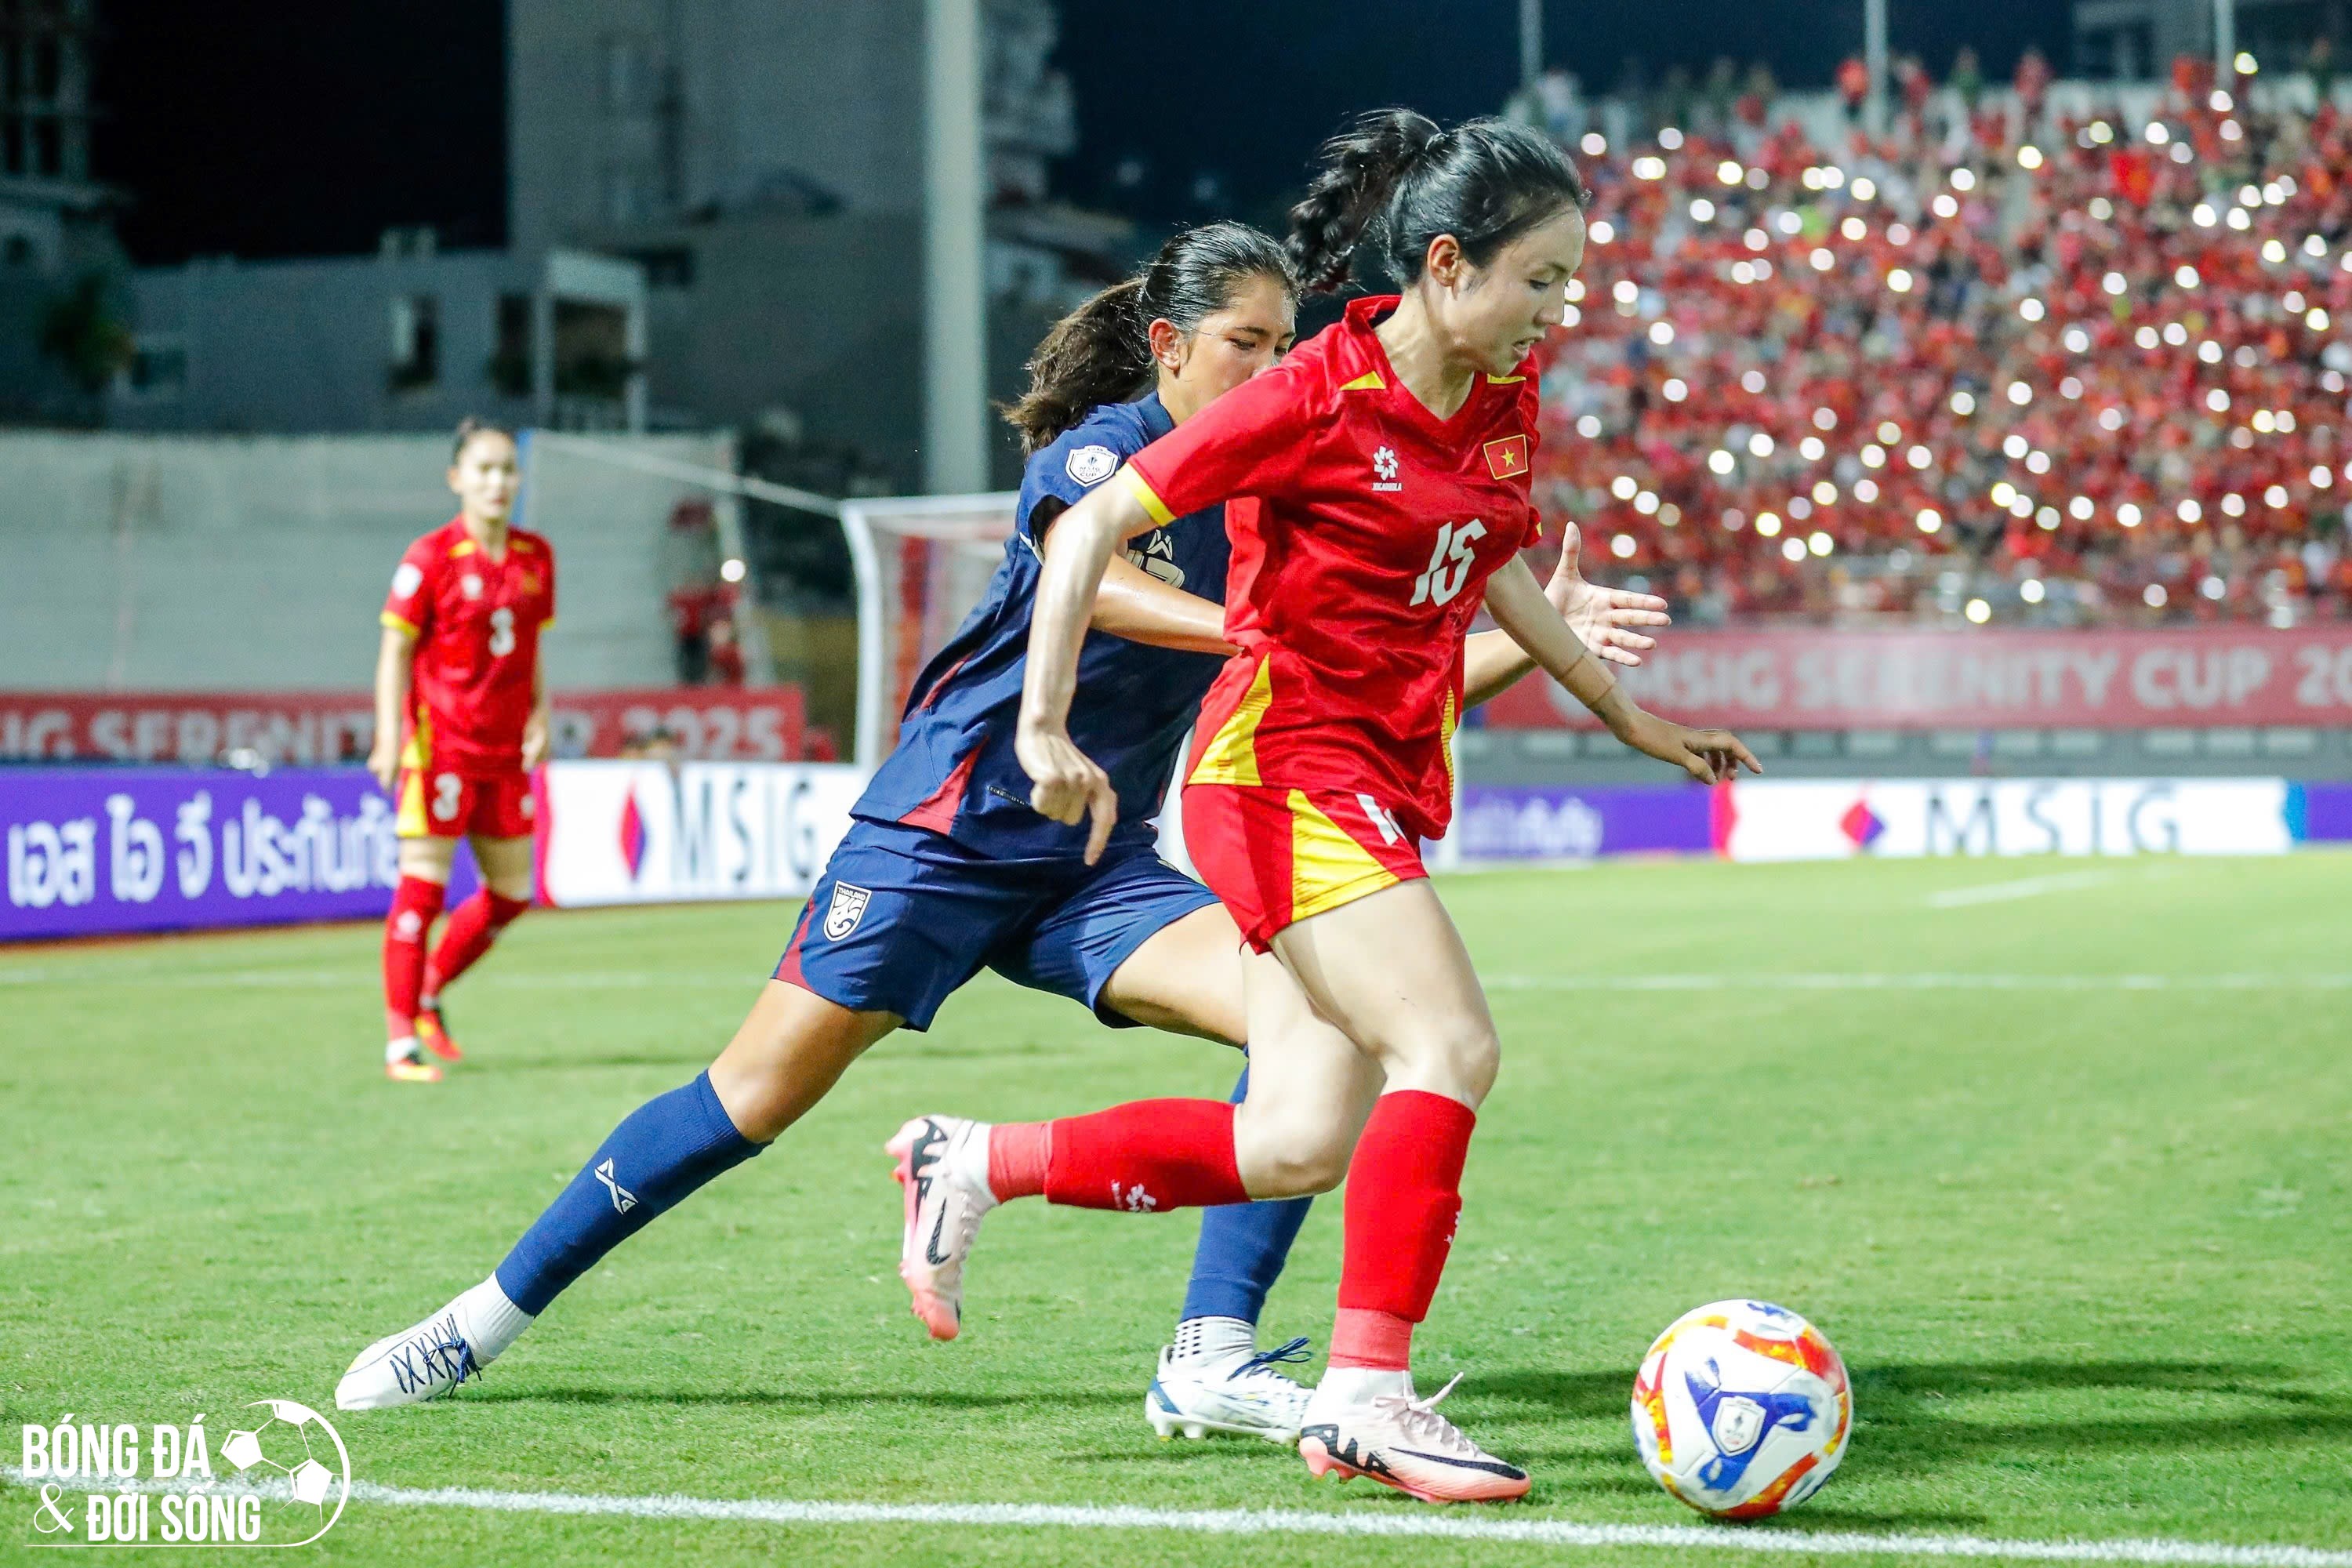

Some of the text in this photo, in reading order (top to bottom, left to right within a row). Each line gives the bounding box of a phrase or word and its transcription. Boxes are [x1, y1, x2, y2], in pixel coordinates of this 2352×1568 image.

[1410, 518, 1487, 607] 15
[488, 608, 516, 657] 3
[2132, 646, 2271, 710] CUP
[0, 710, 75, 759] IG
[91, 710, 376, 760] SERENIT
[433, 773, 463, 822] 3
[670, 775, 817, 882] MSIG
[1926, 784, 2180, 856] MSIG
